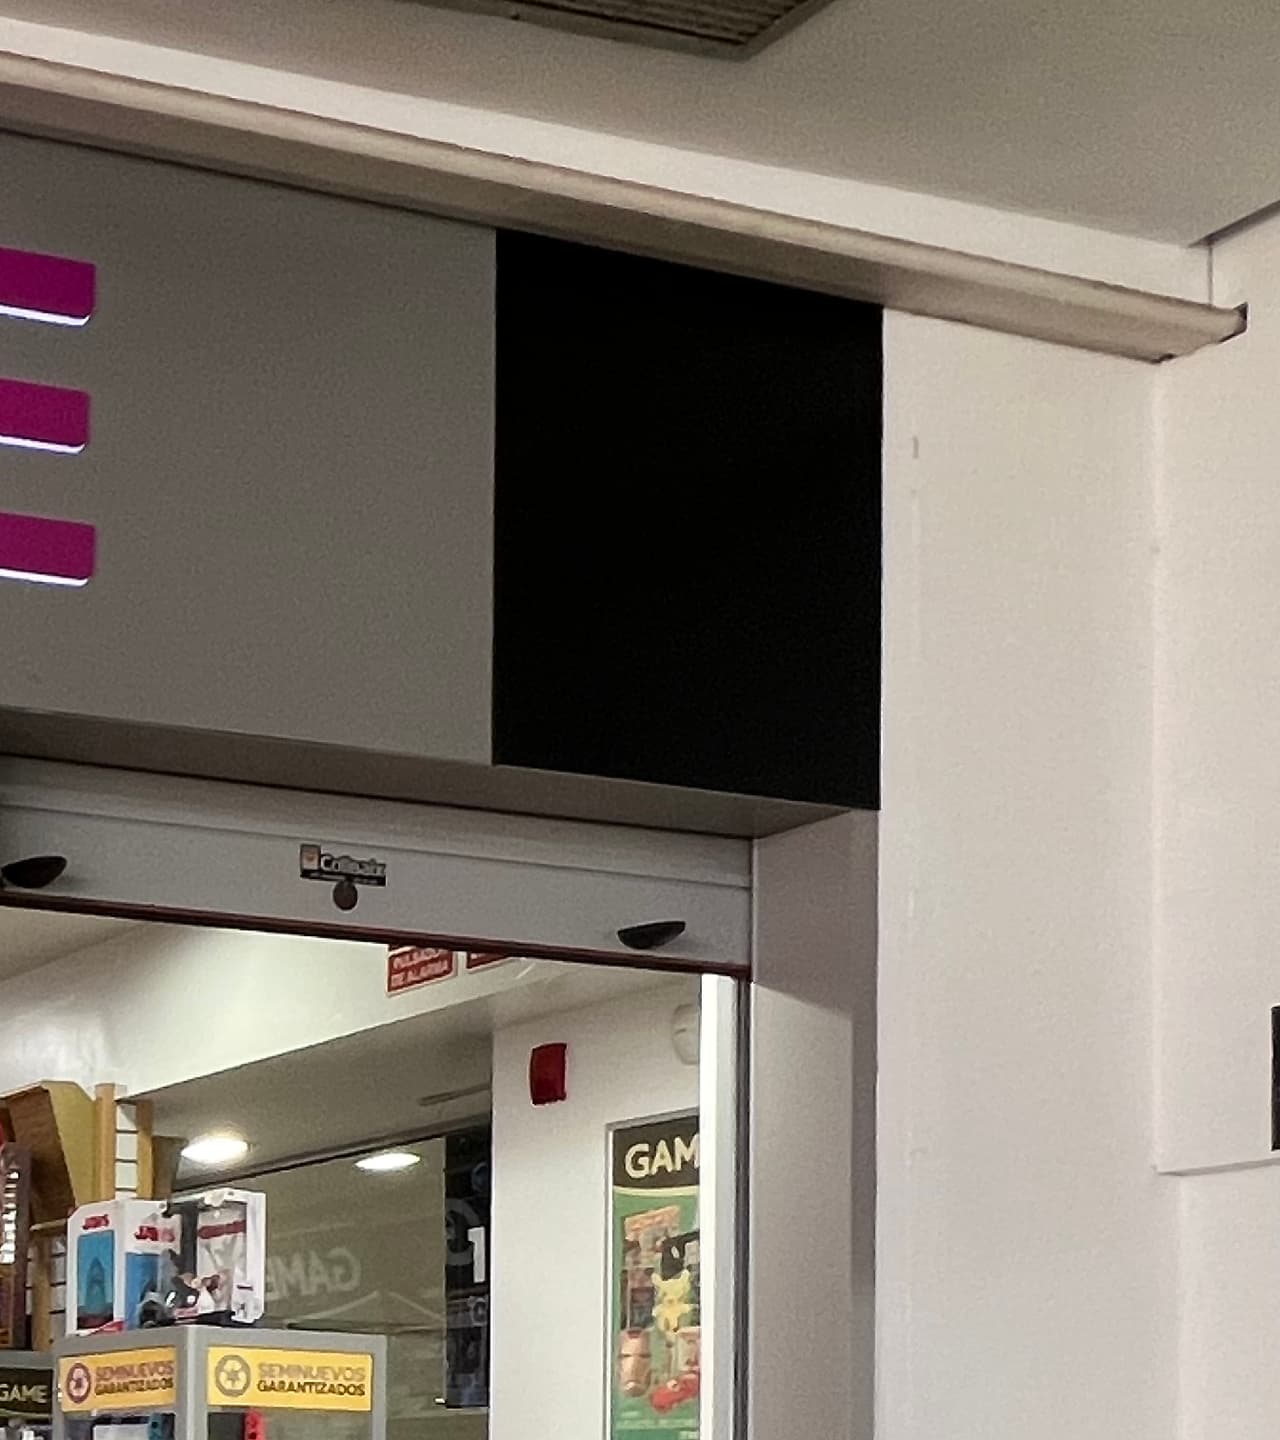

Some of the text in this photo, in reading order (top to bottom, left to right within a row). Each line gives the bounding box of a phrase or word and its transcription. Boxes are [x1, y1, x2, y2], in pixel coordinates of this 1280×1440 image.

[256, 1360, 366, 1382] SEMINUEVOS
[94, 1377, 174, 1397] GARANTIZADOS
[256, 1378, 366, 1398] GARANTIZADOS
